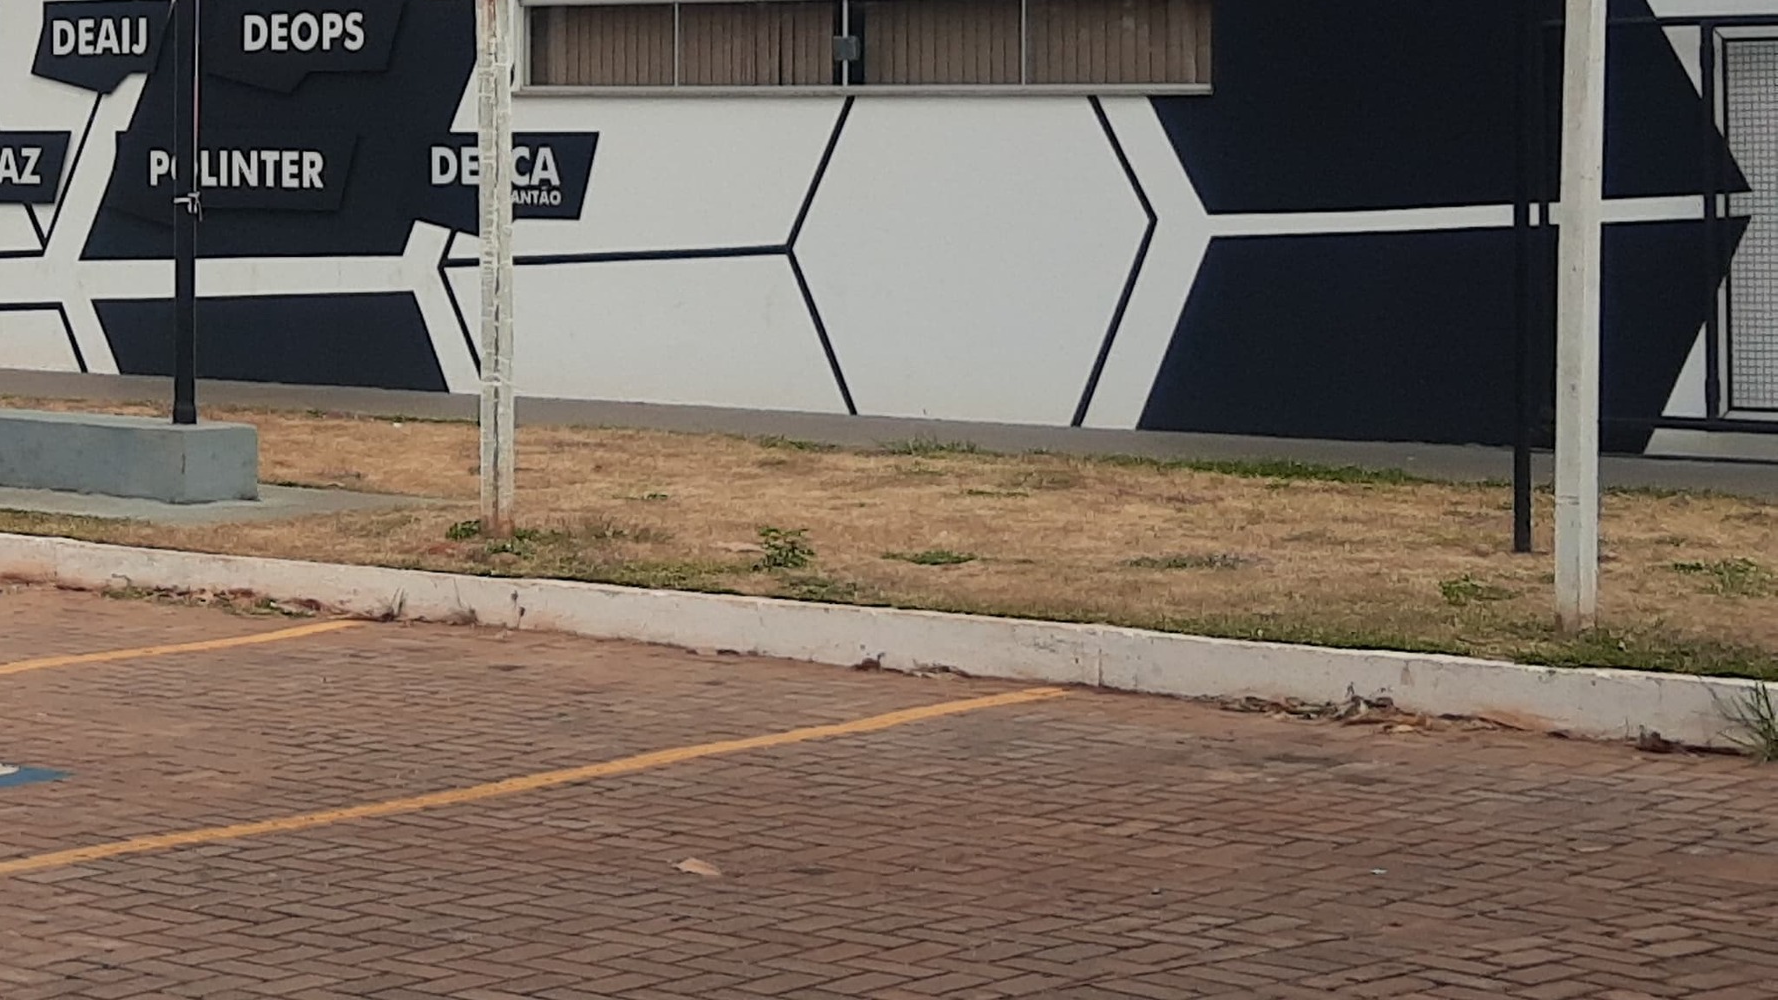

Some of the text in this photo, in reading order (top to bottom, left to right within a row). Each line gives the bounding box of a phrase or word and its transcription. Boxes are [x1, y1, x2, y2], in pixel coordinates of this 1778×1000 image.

[52, 17, 148, 56] DEAIJ
[243, 11, 365, 52] DEOPS
[149, 150, 324, 188] PLINTER
[431, 146, 561, 187] DECA
